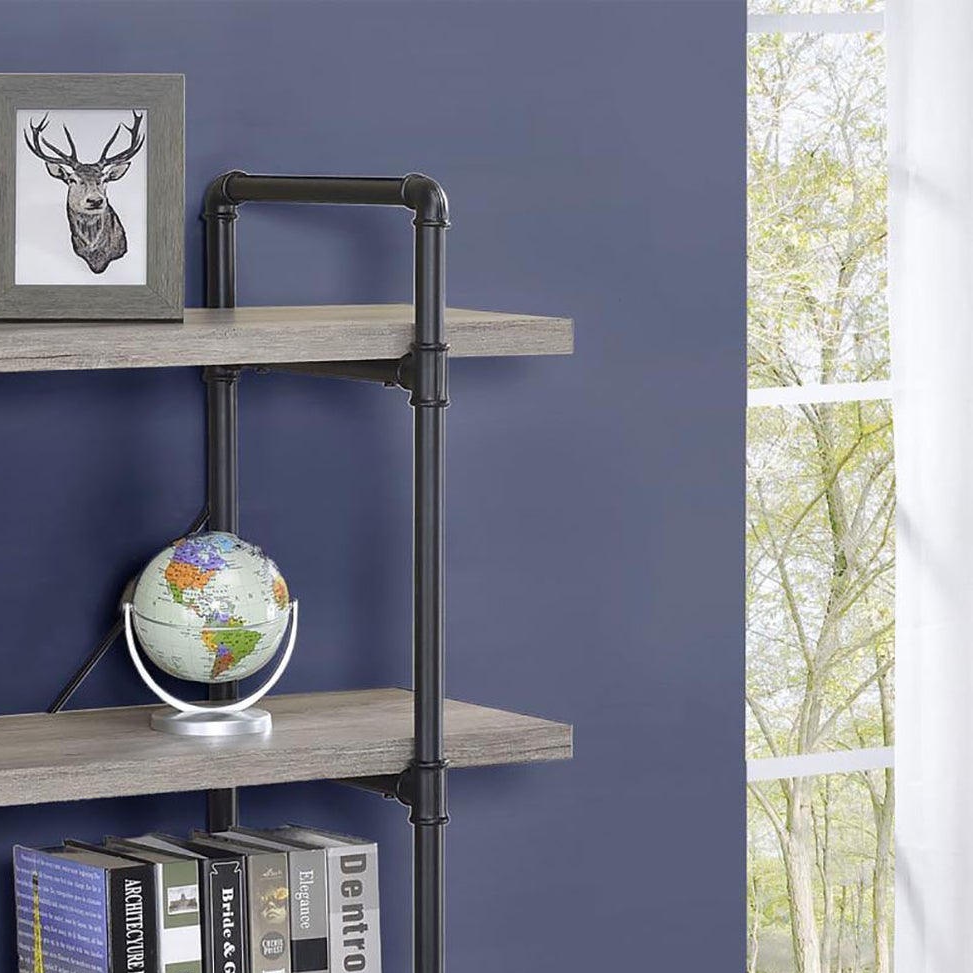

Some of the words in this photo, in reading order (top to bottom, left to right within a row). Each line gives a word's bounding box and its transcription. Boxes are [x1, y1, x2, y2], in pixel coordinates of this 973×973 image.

[222, 887, 235, 938] Bride
[295, 870, 314, 929] Elegance
[341, 854, 368, 973] Dentro
[223, 941, 236, 958] &
